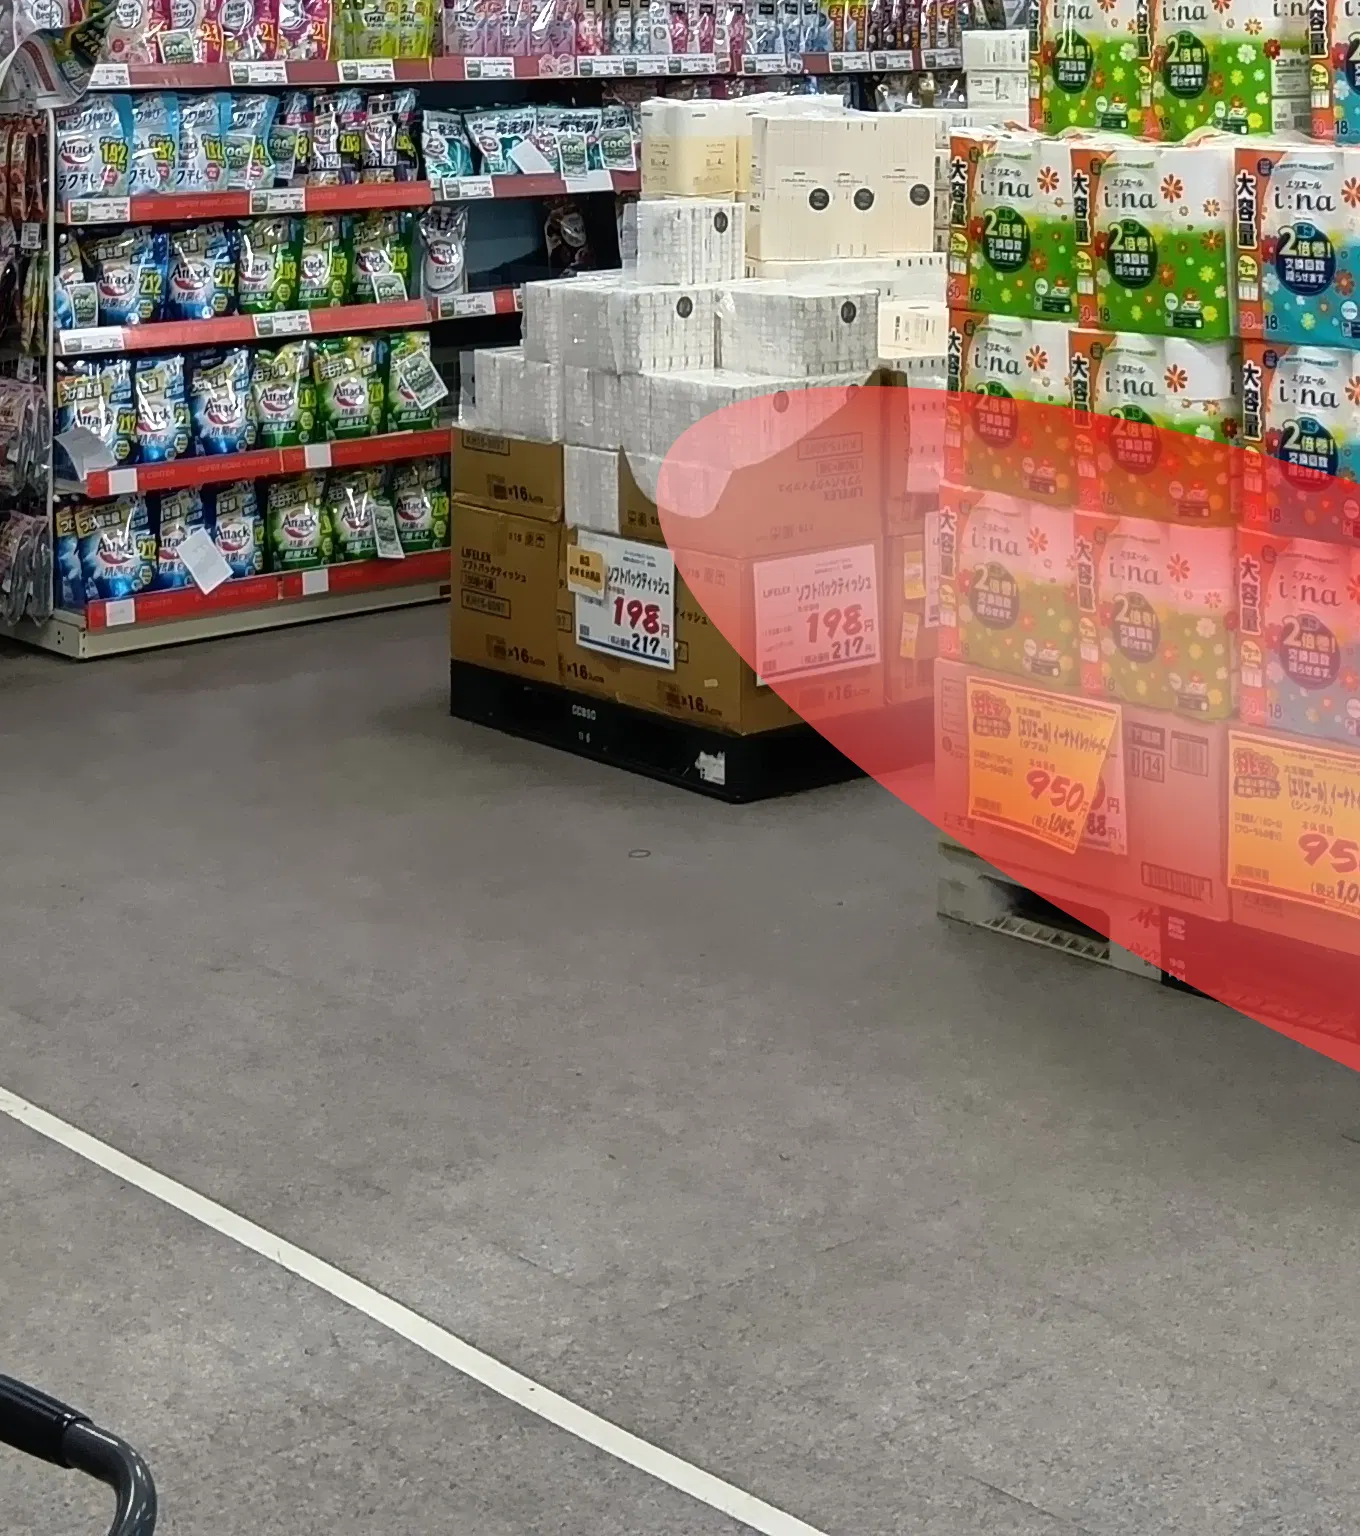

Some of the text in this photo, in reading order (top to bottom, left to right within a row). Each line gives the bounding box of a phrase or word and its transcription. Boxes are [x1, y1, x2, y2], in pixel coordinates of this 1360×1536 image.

[951, 159, 967, 226] 大容量
[1073, 172, 1090, 244] 大容量
[1237, 172, 1257, 247] 大容量
[1243, 363, 1262, 440] 大容量
[216, 526, 250, 539] Attack
[796, 576, 872, 602] ソフトパックティッシュ
